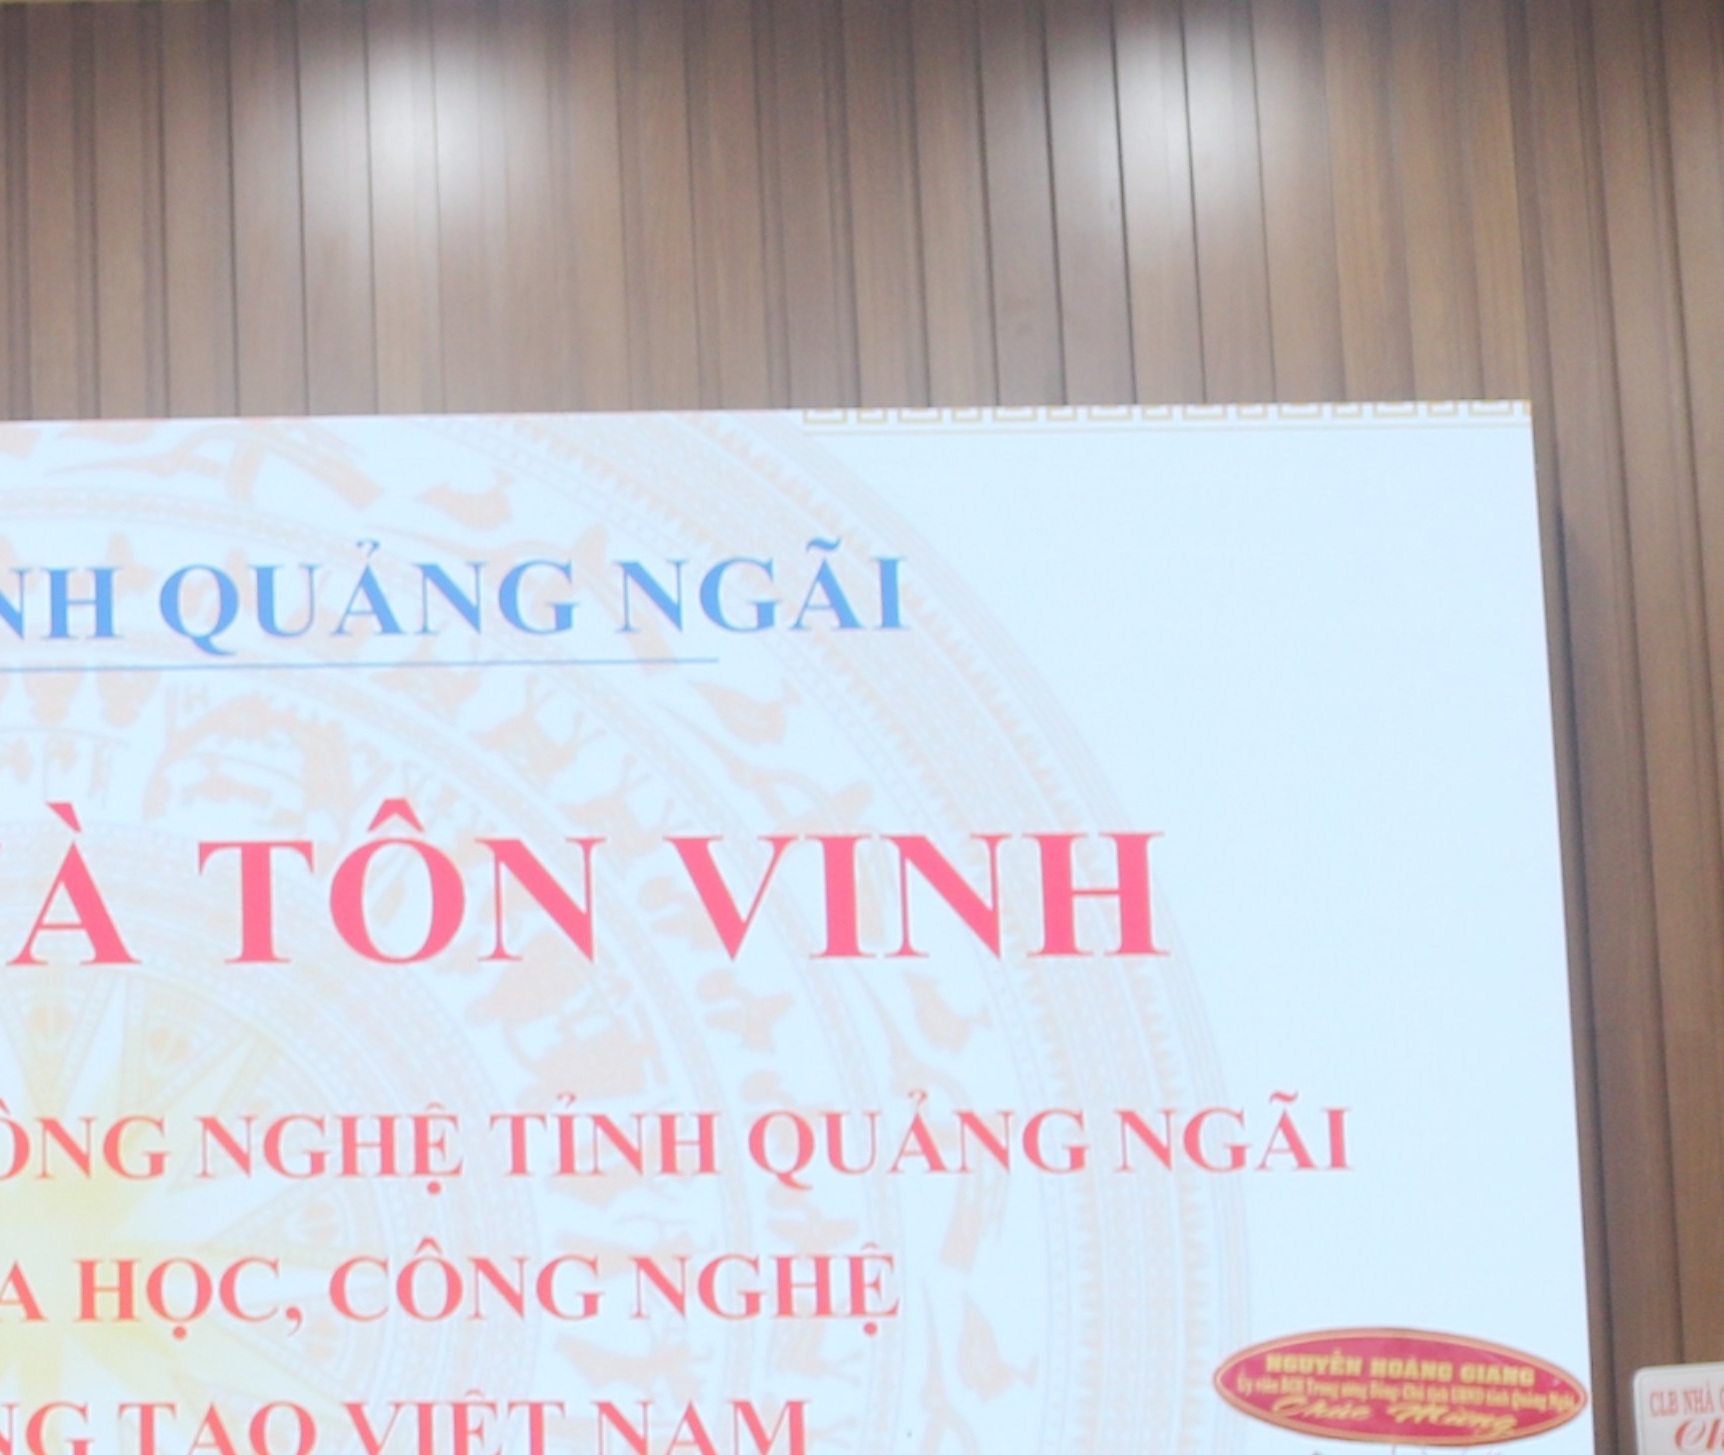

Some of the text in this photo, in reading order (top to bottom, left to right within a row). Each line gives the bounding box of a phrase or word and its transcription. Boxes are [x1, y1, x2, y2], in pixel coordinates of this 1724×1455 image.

[157, 539, 579, 657] QUẢNG
[615, 536, 909, 633] NGÃI
[197, 797, 602, 965] TÔN
[665, 830, 1170, 959] VINH
[198, 1102, 463, 1195] NGHỆ
[489, 1092, 719, 1176] TỈNH
[747, 1088, 1089, 1191] QUẢNG
[1115, 1092, 1350, 1172] NGÃI
[75, 1257, 303, 1340] HỌC,
[329, 1236, 604, 1320] CÔNG
[632, 1242, 899, 1336] NGHỆ
